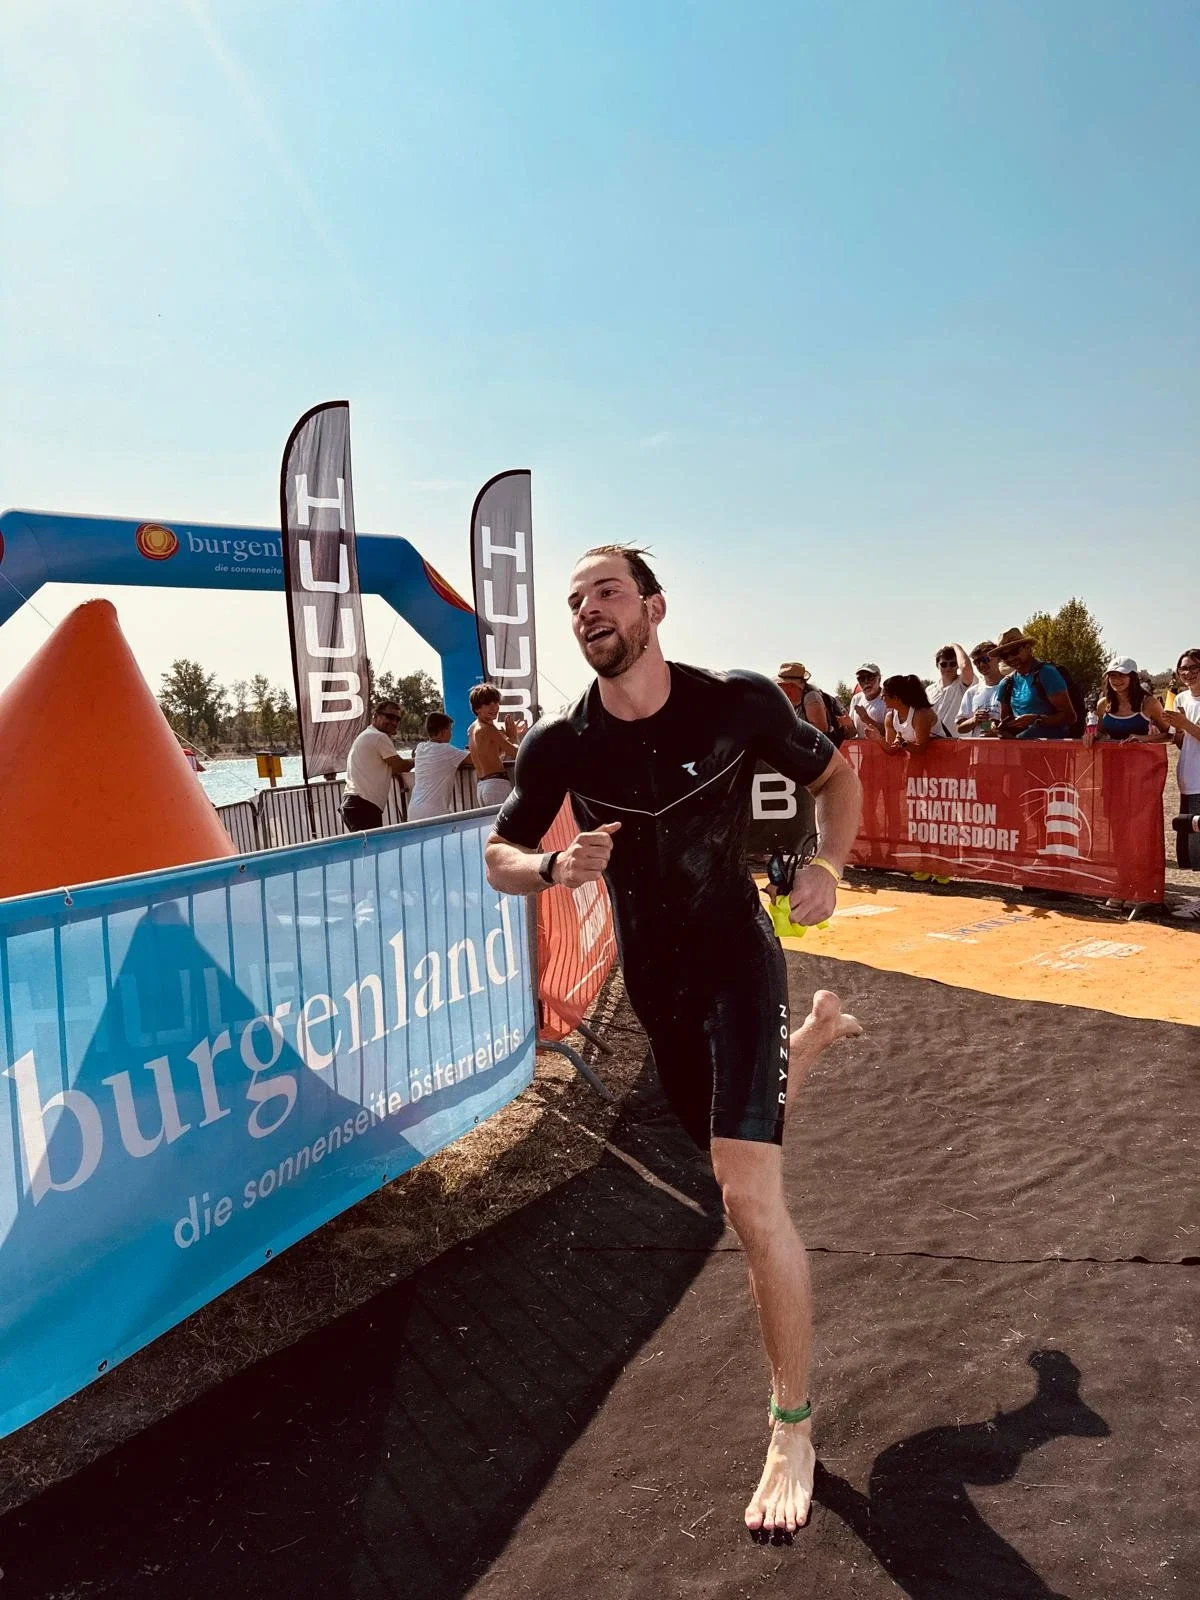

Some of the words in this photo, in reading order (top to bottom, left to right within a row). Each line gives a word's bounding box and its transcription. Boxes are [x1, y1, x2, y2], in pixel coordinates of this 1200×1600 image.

[214, 564, 229, 572] die
[230, 566, 282, 575] sonnenseite
[294, 474, 365, 724] HUUB
[906, 777, 977, 800] AUSTRIA
[907, 799, 997, 826] TRIATHLON
[908, 821, 1019, 852] PODERSDORF
[2, 899, 519, 1207] burgenland
[778, 1004, 788, 1104] RYZON
[174, 1200, 233, 1249] die
[242, 1092, 402, 1208] sonnenseite
[408, 1027, 524, 1104] österreichs
